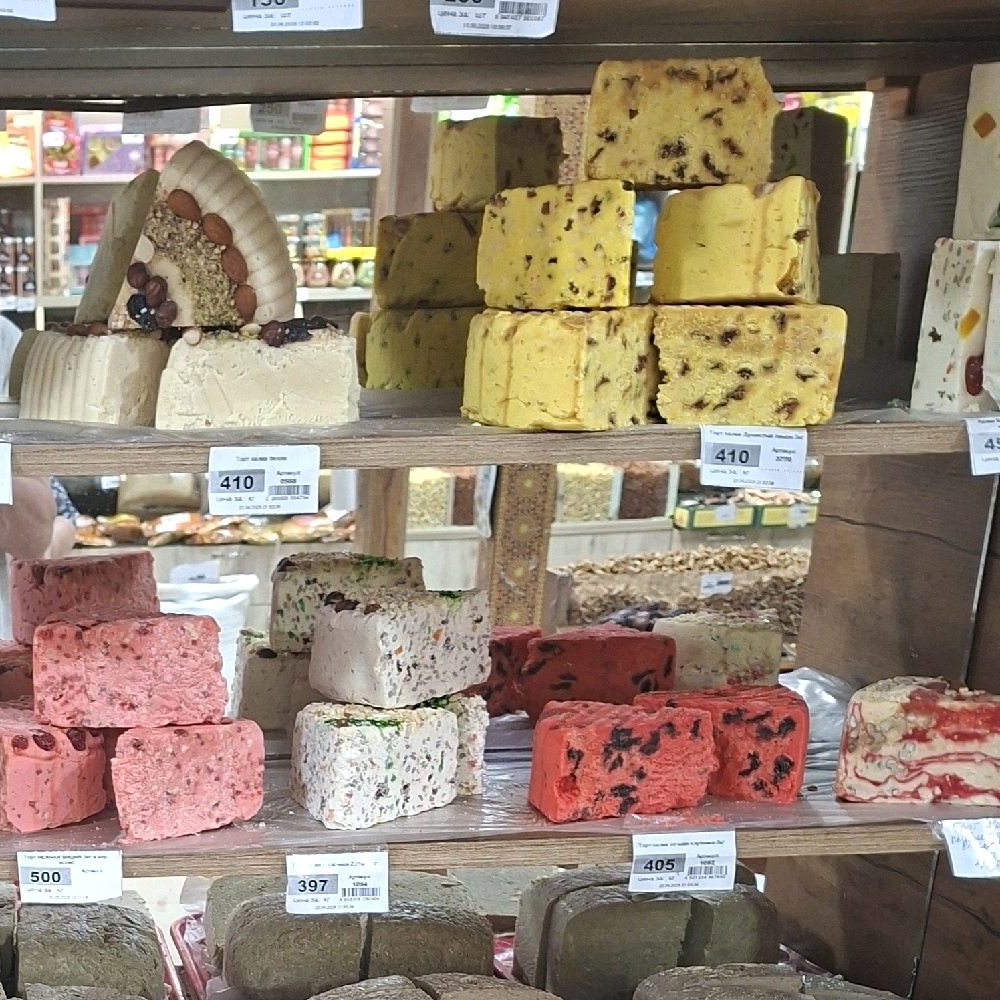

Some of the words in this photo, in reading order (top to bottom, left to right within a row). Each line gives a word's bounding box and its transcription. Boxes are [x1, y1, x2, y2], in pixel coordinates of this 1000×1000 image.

[714, 448, 750, 464] 410
[220, 475, 254, 490] 410
[643, 859, 675, 872] 405
[30, 871, 61, 883] 500
[297, 879, 329, 892] 397
